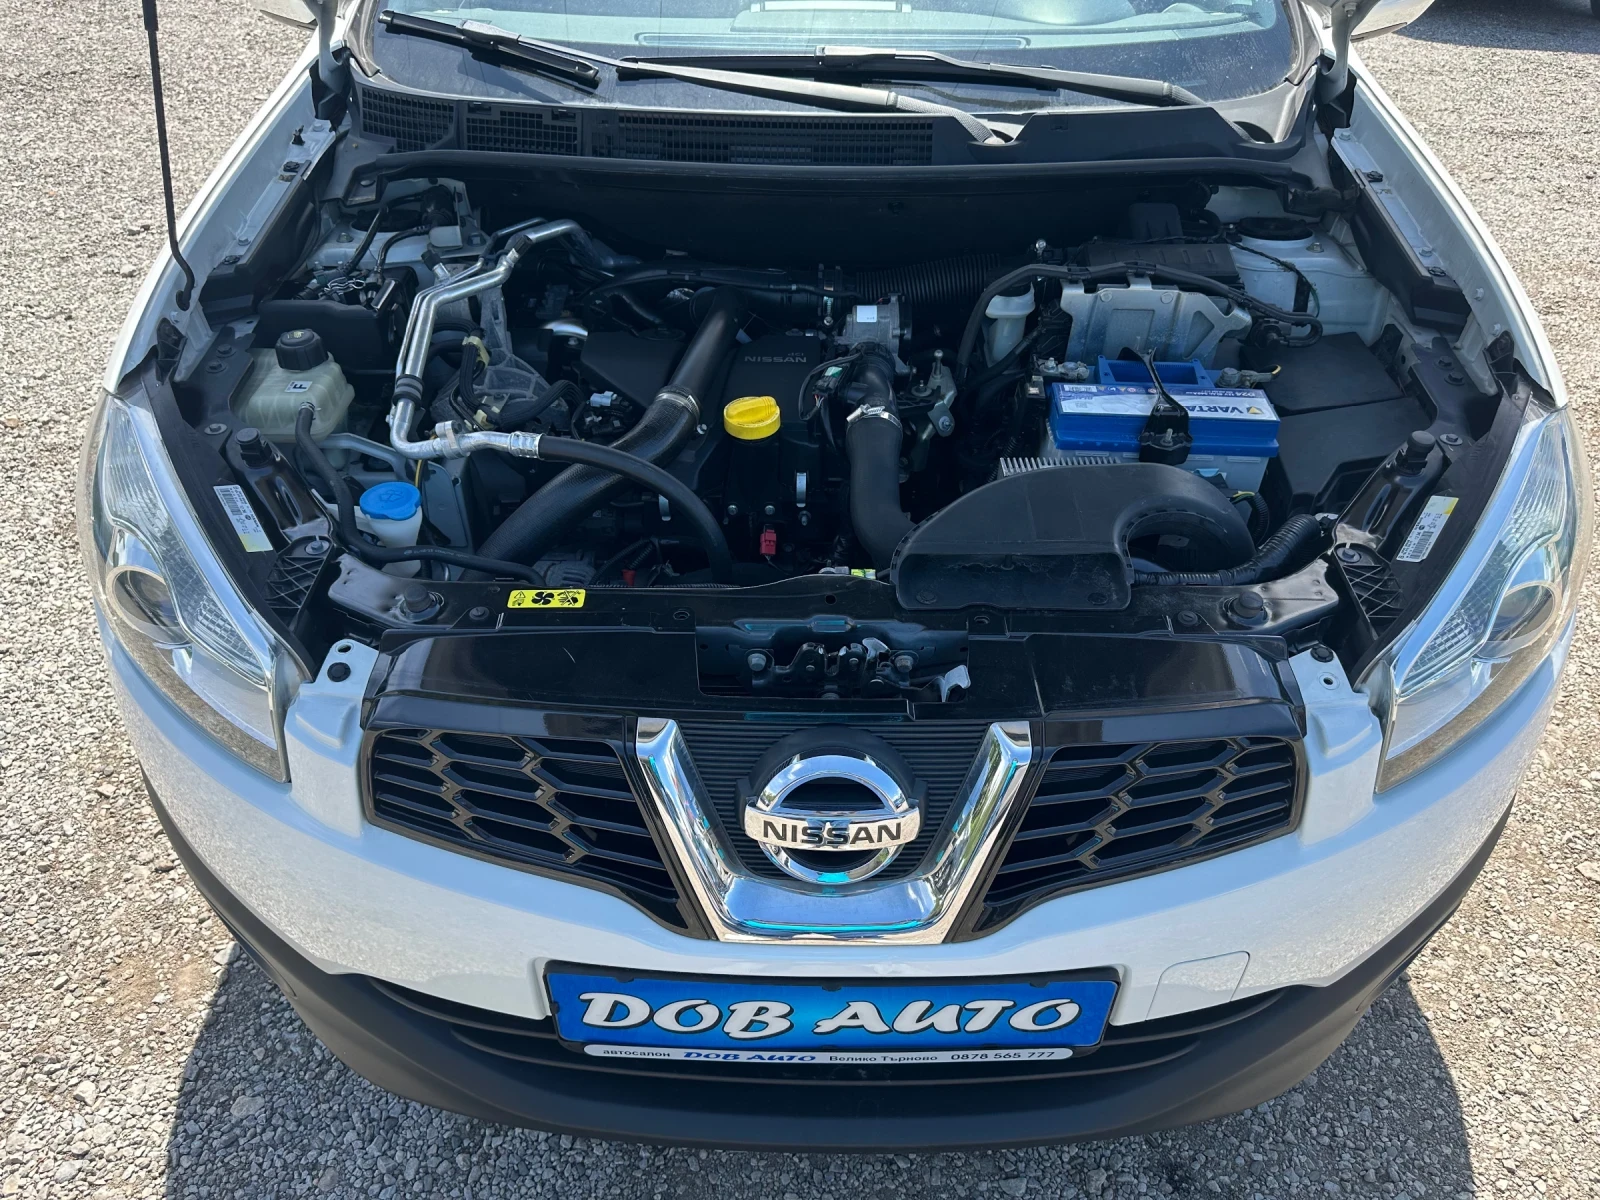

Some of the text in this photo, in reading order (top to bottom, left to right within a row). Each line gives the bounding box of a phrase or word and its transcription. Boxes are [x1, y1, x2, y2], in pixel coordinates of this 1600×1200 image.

[1184, 405, 1244, 414] VARTA
[763, 820, 902, 846] NISSAN
[578, 992, 1082, 1040] DOB AUTO
[602, 1048, 671, 1058] автосалон
[683, 1051, 816, 1062] DOB AUTO
[829, 1054, 938, 1063] Велико Търново
[950, 1050, 1056, 1061] 0878 565 777
